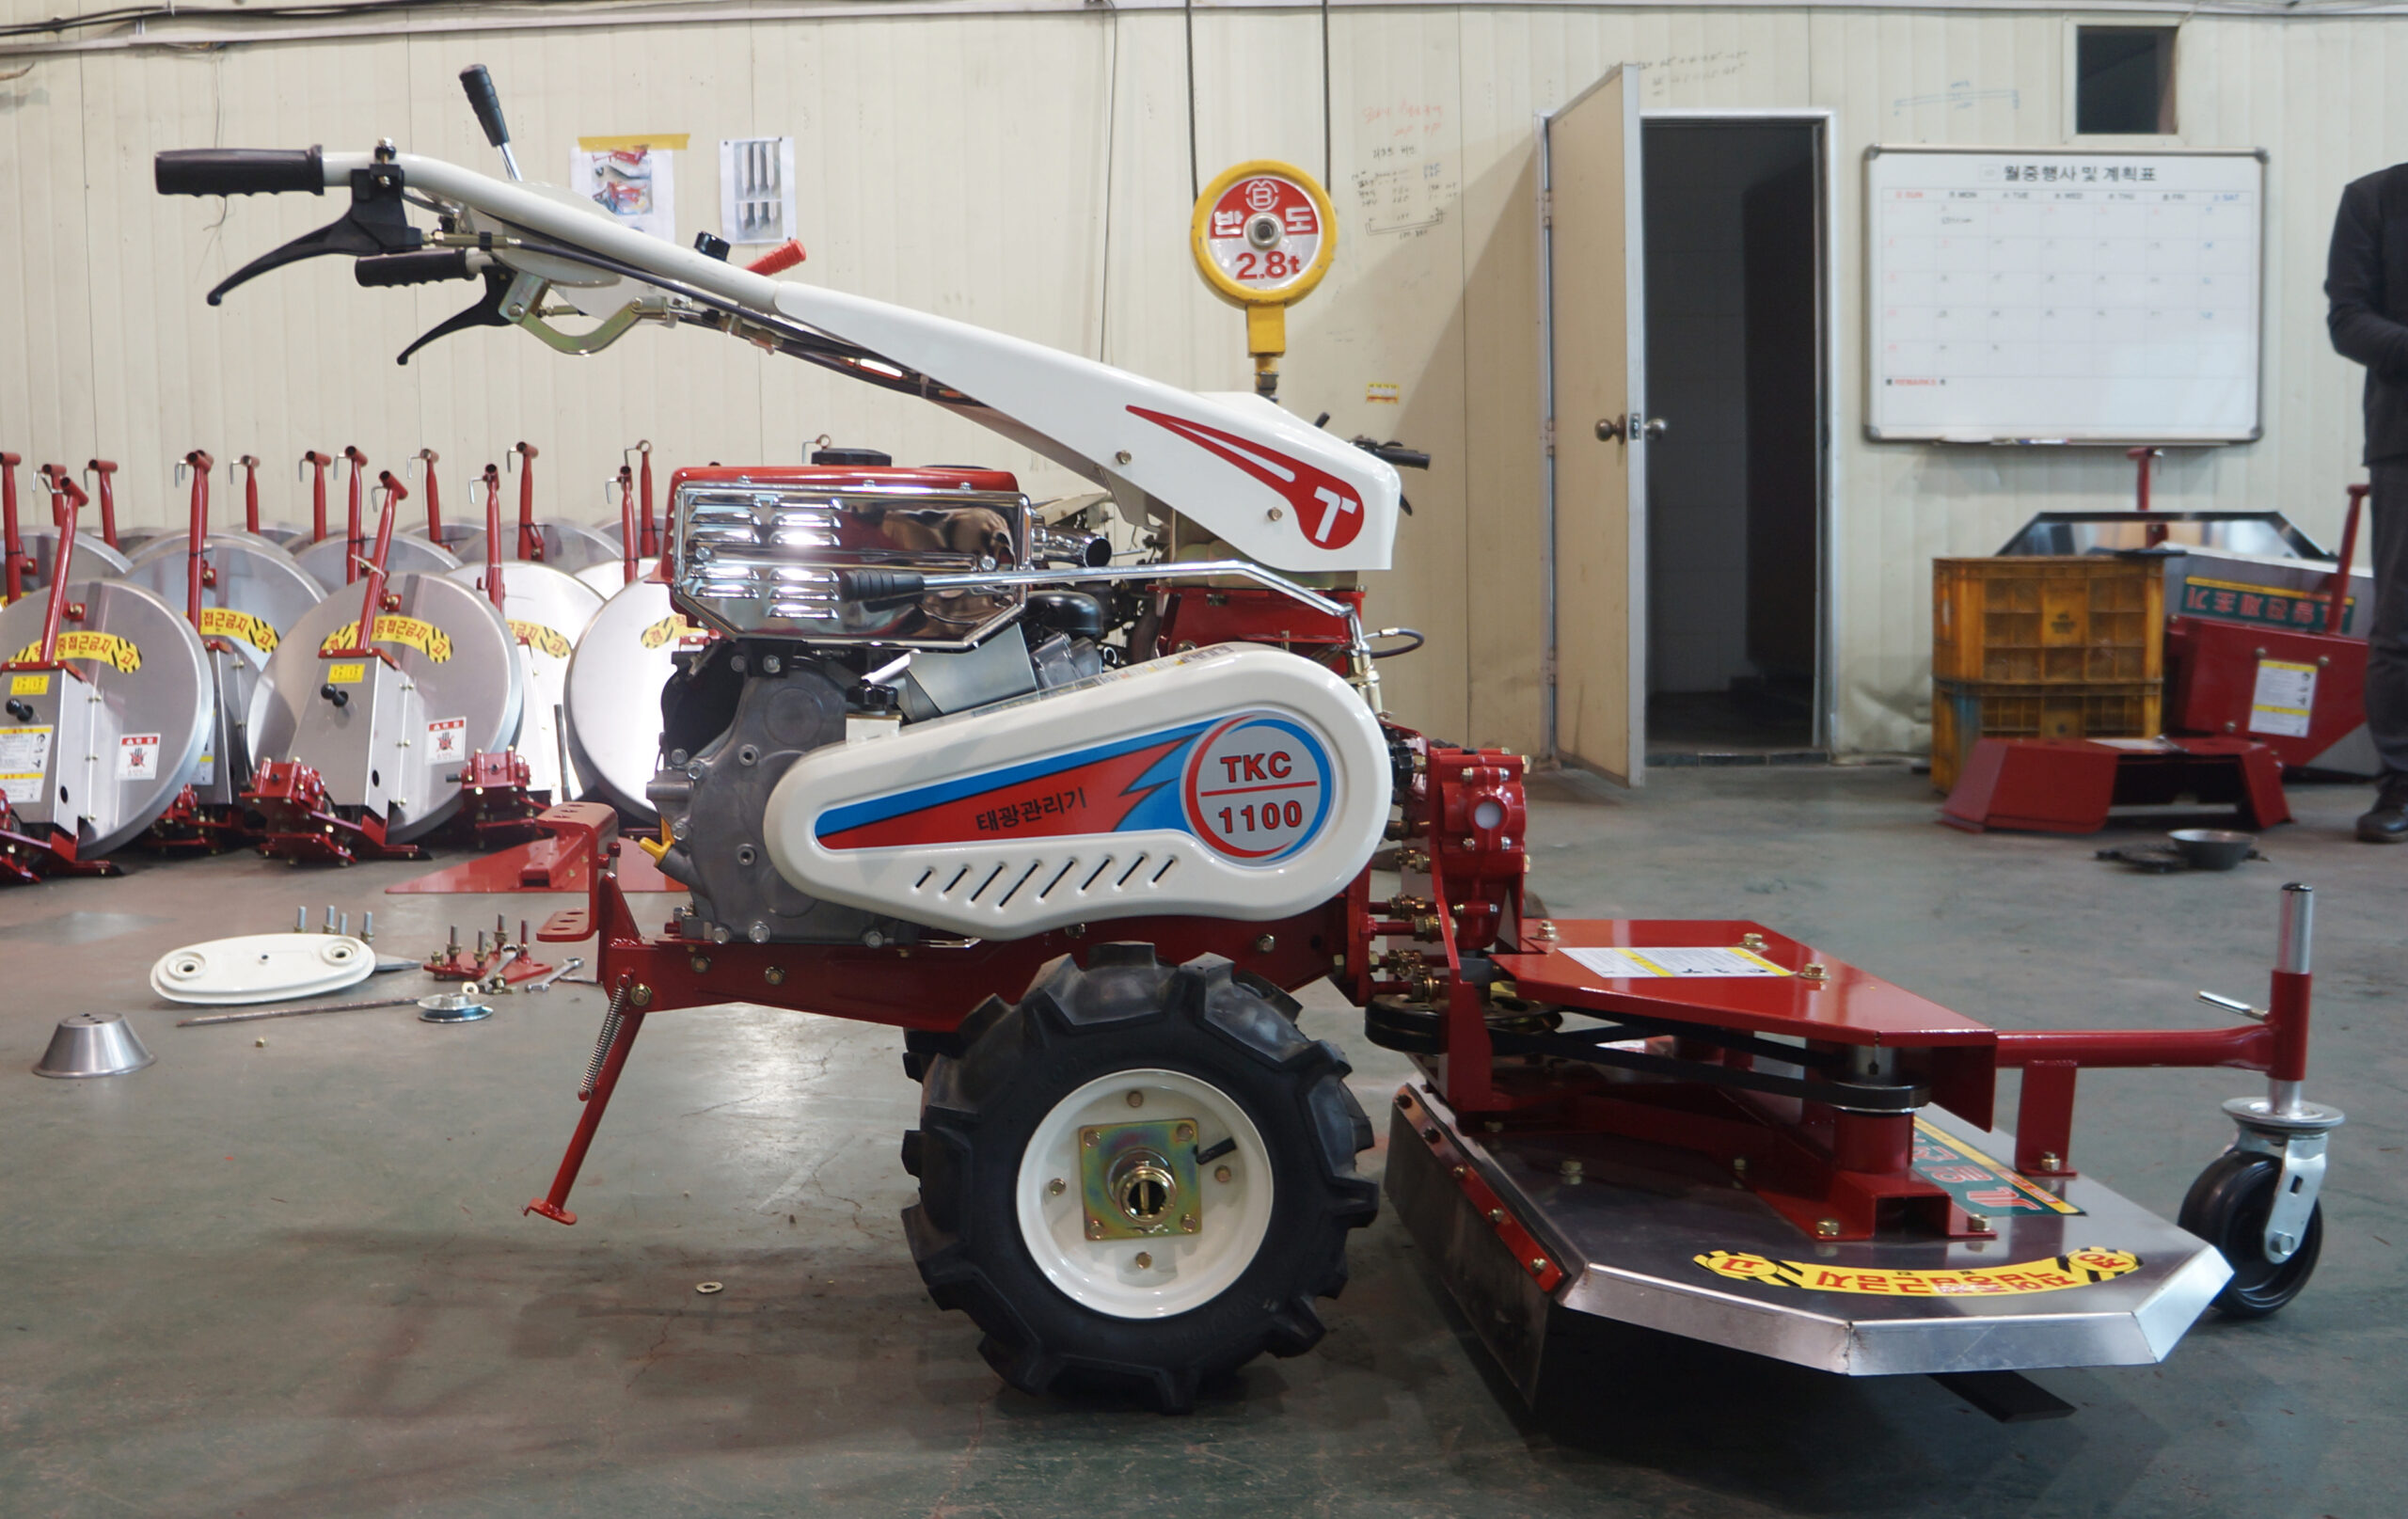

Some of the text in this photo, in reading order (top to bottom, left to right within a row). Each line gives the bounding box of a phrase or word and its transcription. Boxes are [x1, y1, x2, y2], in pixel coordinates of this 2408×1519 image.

[2004, 165, 2077, 182] 월중행사
[2081, 165, 2098, 182] 및
[2102, 165, 2157, 182] 계획표
[1235, 250, 1301, 280] 2.8t
[202, 611, 248, 633] 접근금지
[1220, 751, 1292, 783] TKC
[975, 787, 1087, 831] 태광관리기
[1218, 799, 1303, 833] 1100
[1719, 1258, 1765, 1274] 고
[2078, 1254, 2130, 1269] 경
